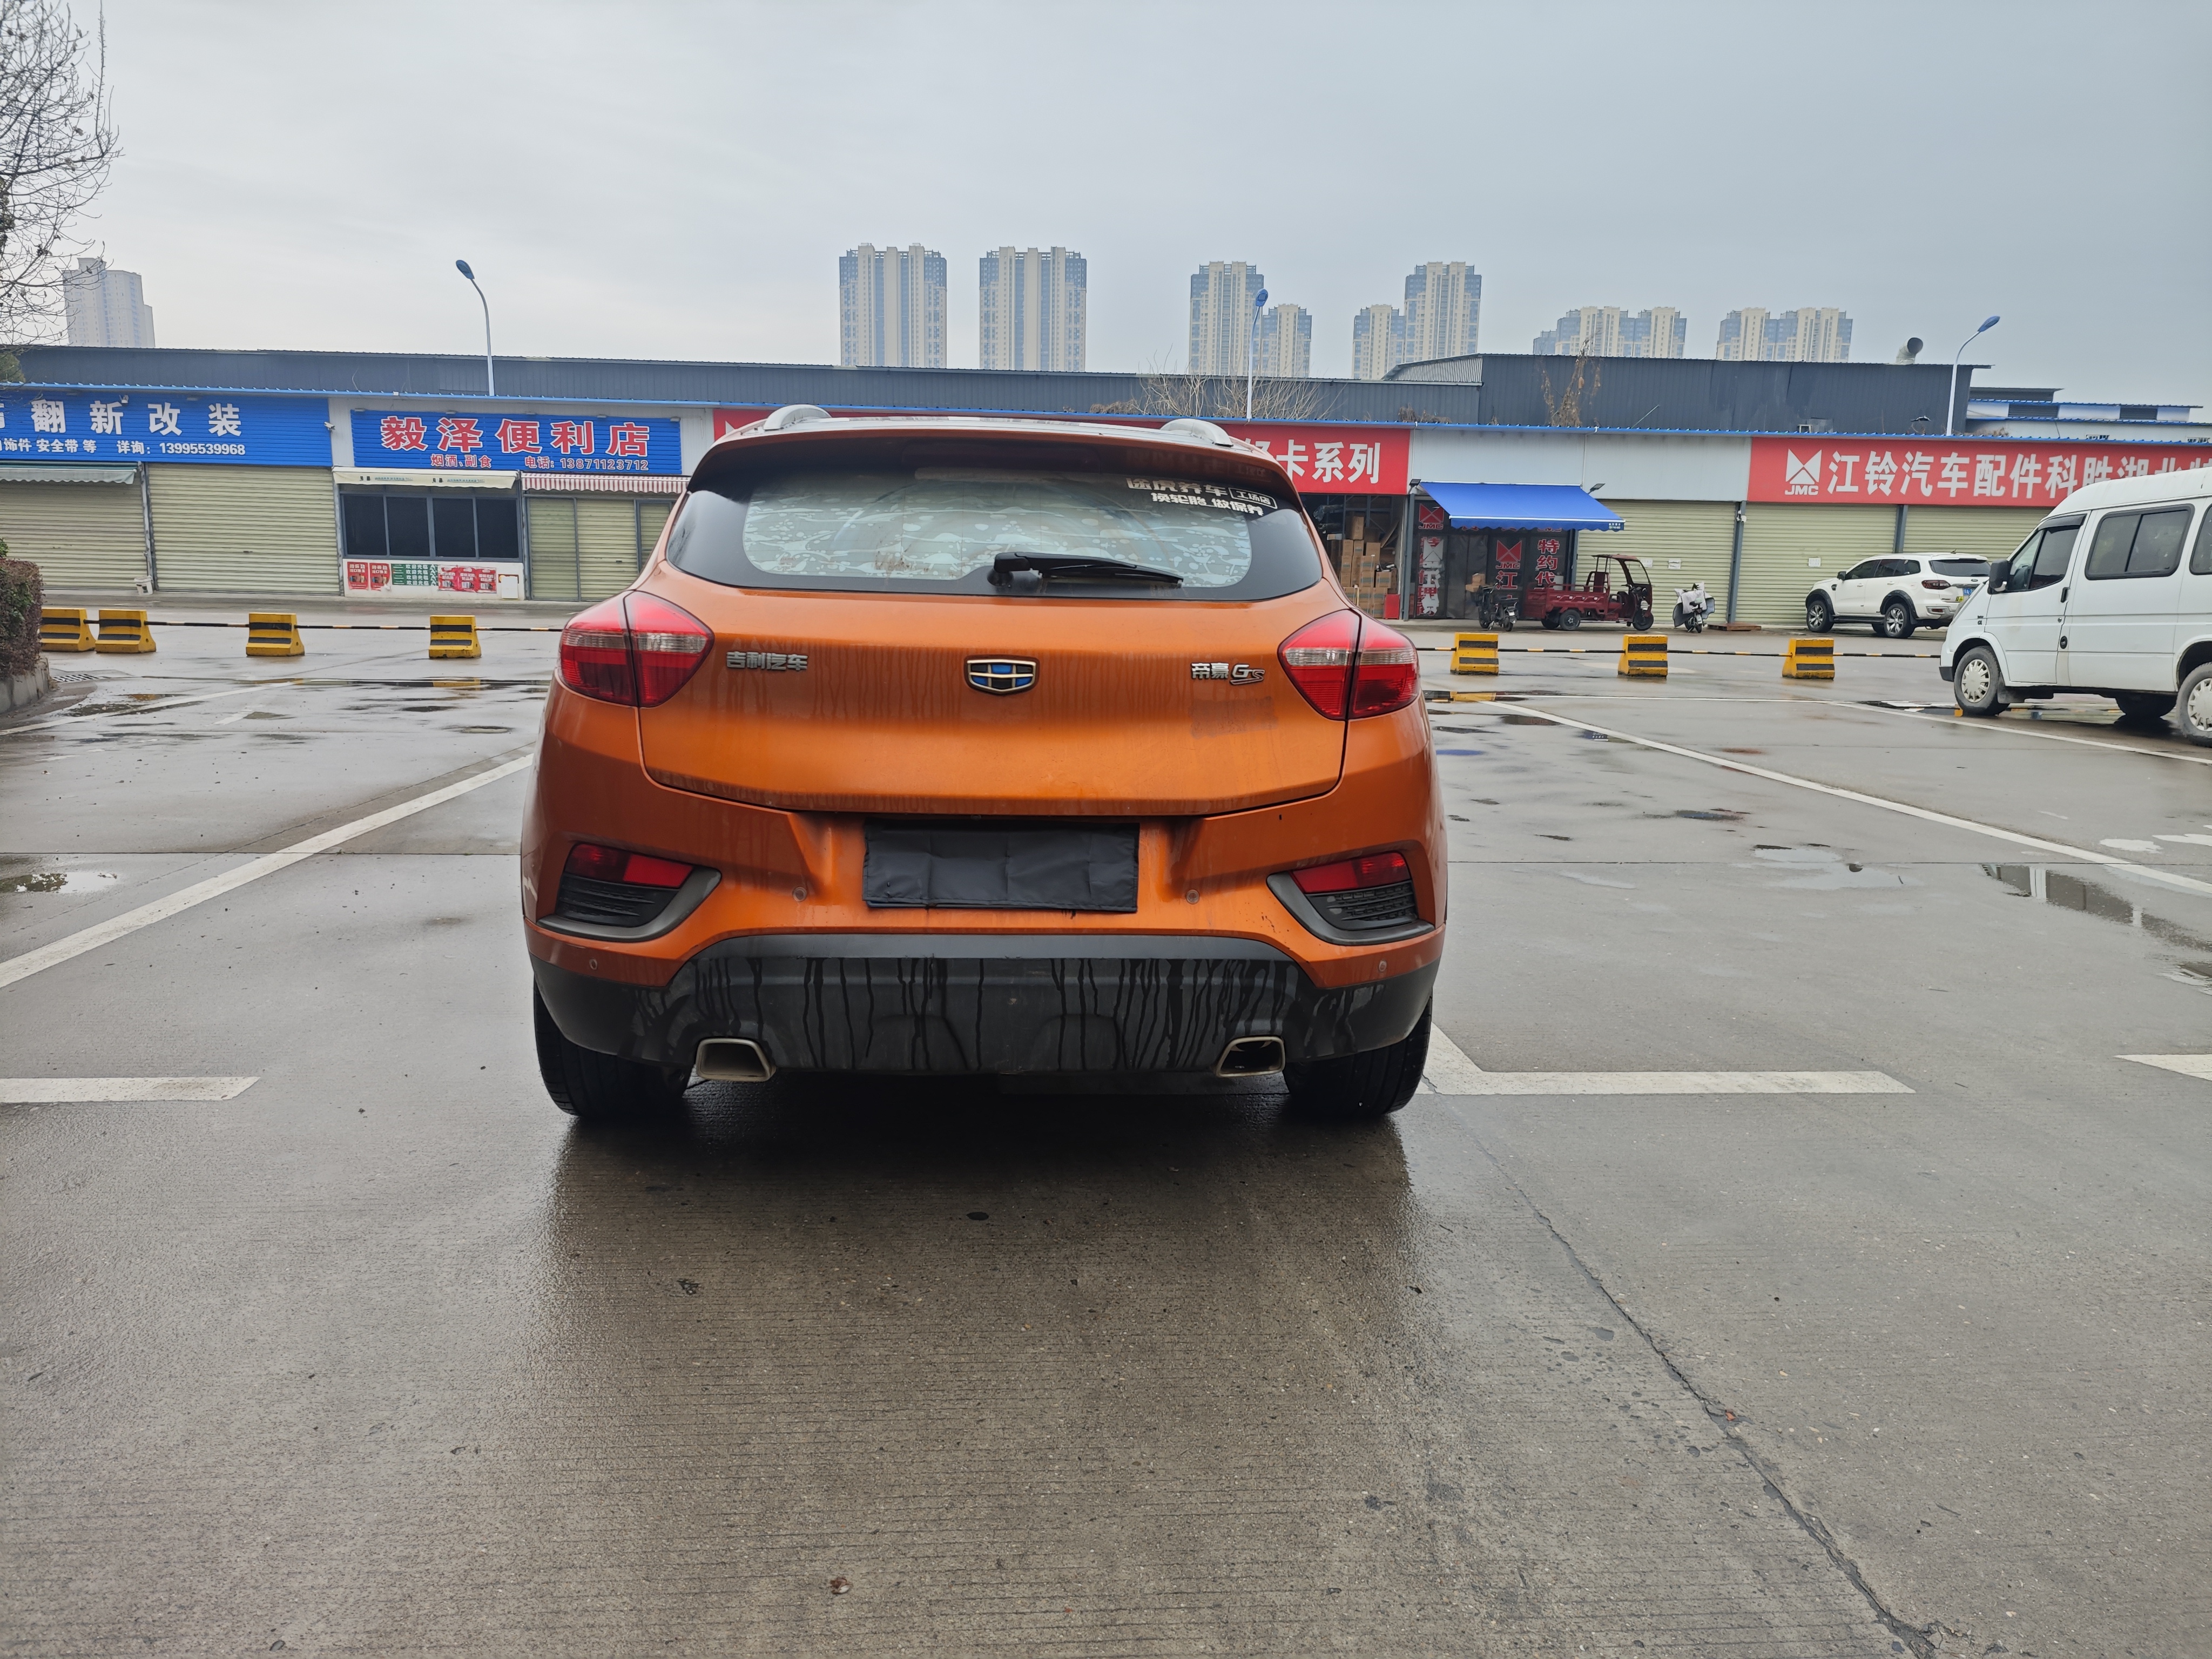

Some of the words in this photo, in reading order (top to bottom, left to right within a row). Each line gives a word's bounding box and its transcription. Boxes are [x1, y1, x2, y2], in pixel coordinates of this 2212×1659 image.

[0, 399, 242, 437] 翻新改装
[0, 437, 32, 452] 饰件
[36, 439, 79, 453] 安全带
[83, 439, 97, 454] 等
[159, 442, 246, 455] 13995539968
[380, 416, 650, 457] 毅泽便利店
[560, 457, 649, 471] 13871123712
[1126, 478, 1228, 496] 途虎养车
[1236, 490, 1271, 505] 工场店
[1785, 485, 1819, 496] JMC
[1151, 493, 1207, 506] 换轮胎
[1211, 498, 1264, 516] 做保养
[1535, 539, 1560, 590] 特约代
[726, 651, 808, 671] 吉利汽车
[1191, 662, 1229, 679] 帝豪
